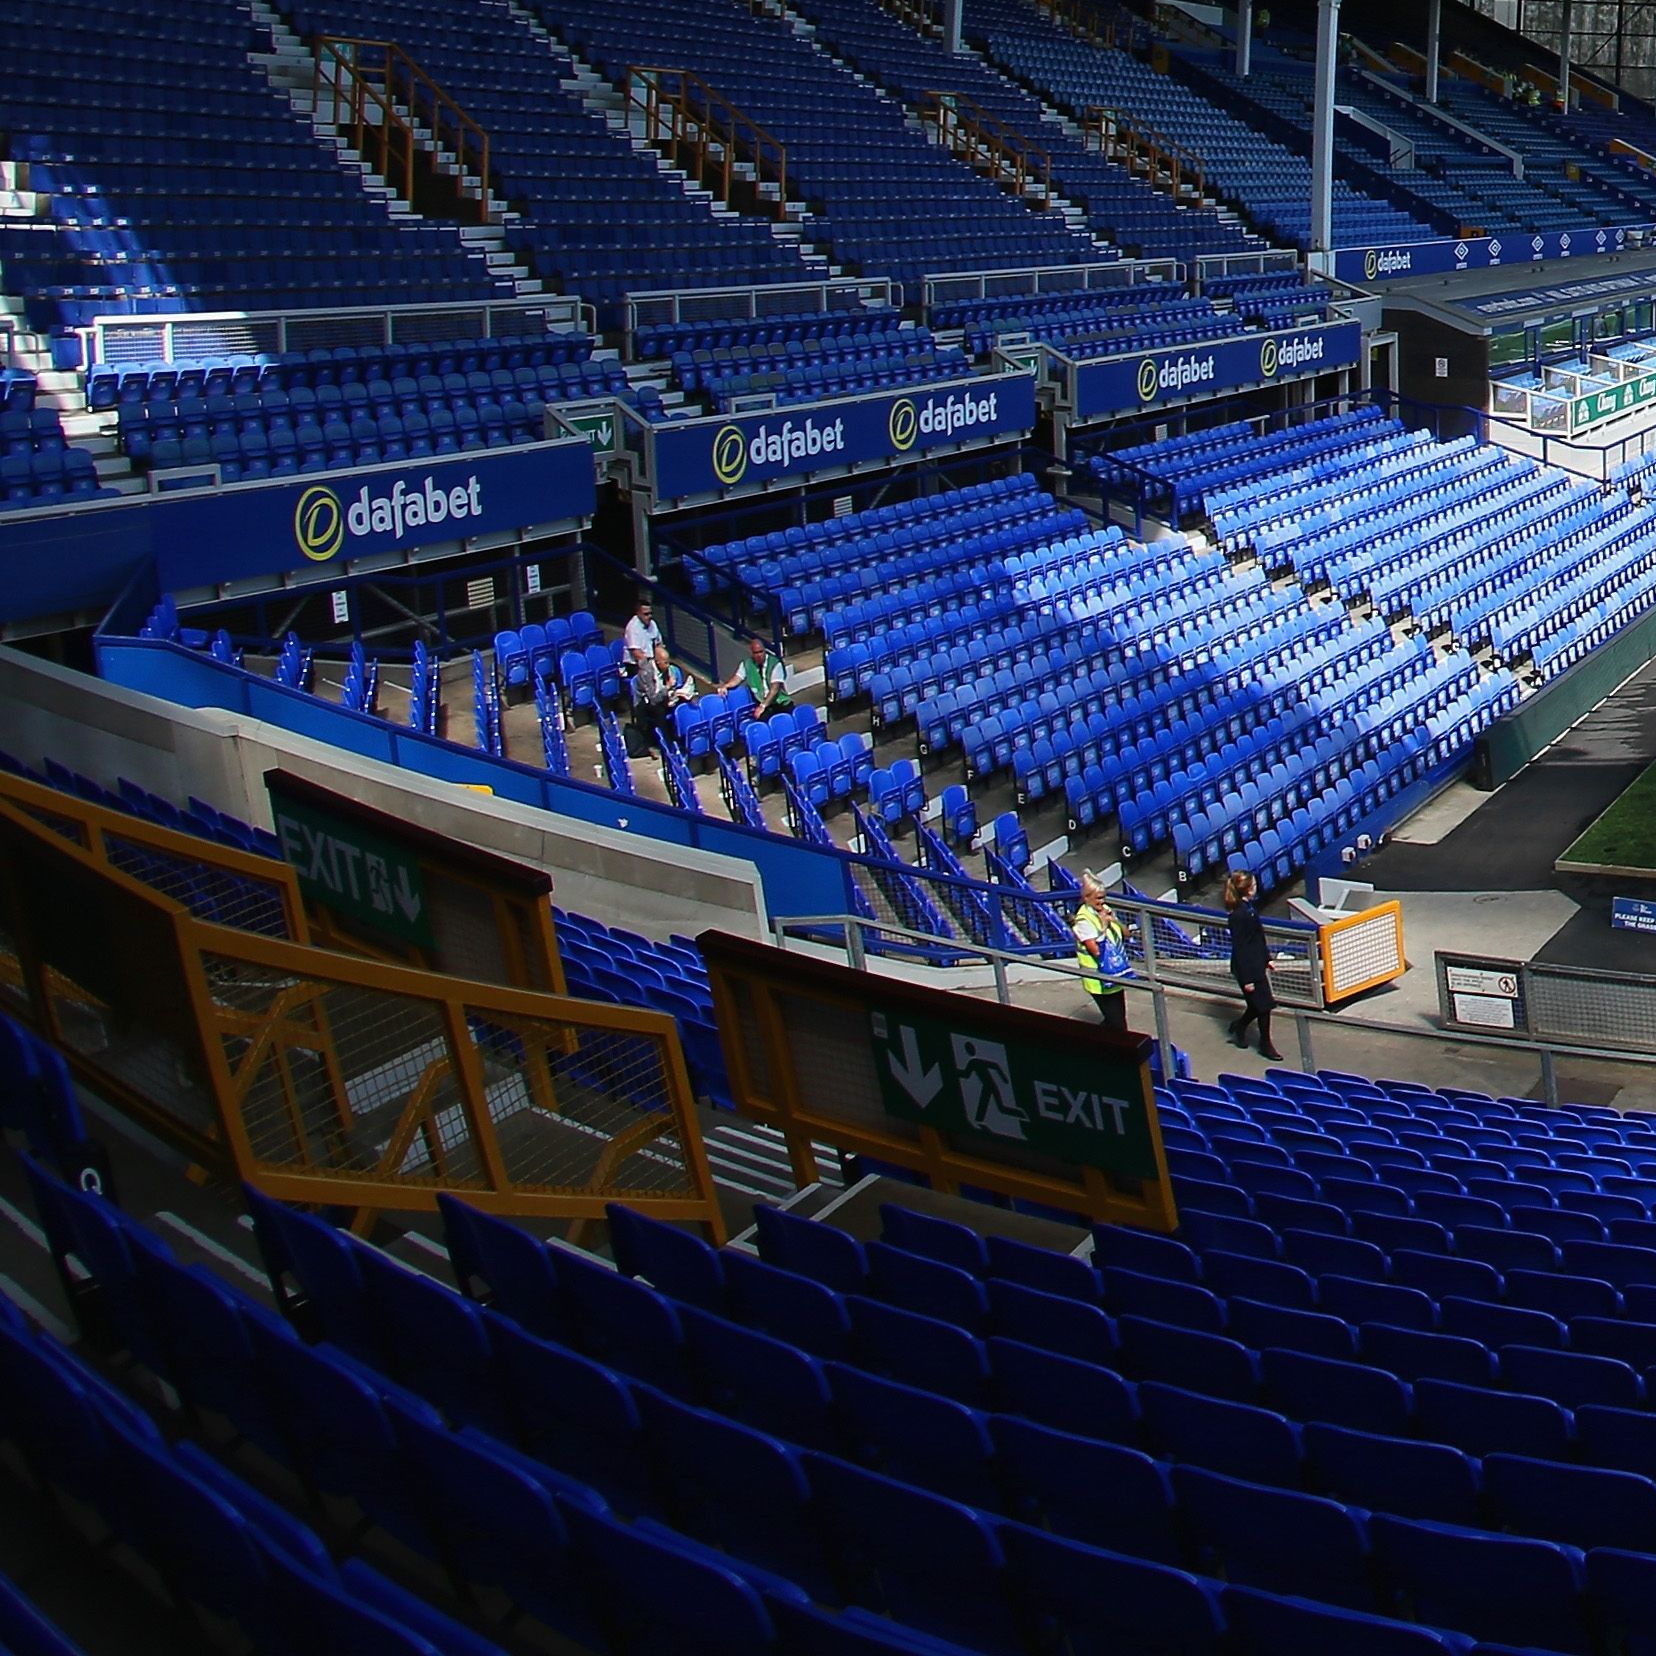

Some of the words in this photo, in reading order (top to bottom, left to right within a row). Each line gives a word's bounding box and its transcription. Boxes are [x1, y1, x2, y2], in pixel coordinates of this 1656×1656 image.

[1377, 250, 1411, 274] dafabet
[1158, 355, 1215, 392] dafabet
[1278, 339, 1325, 370] dafabet
[919, 392, 998, 435] dafabet
[749, 417, 845, 466] dafabet
[347, 475, 483, 539] dafabet
[278, 814, 361, 901] EXIT
[1614, 912, 1638, 922] PLEASE
[1638, 915, 1655, 924] KEEP
[1624, 920, 1637, 928] THE
[1033, 1079, 1129, 1136] EXIT
